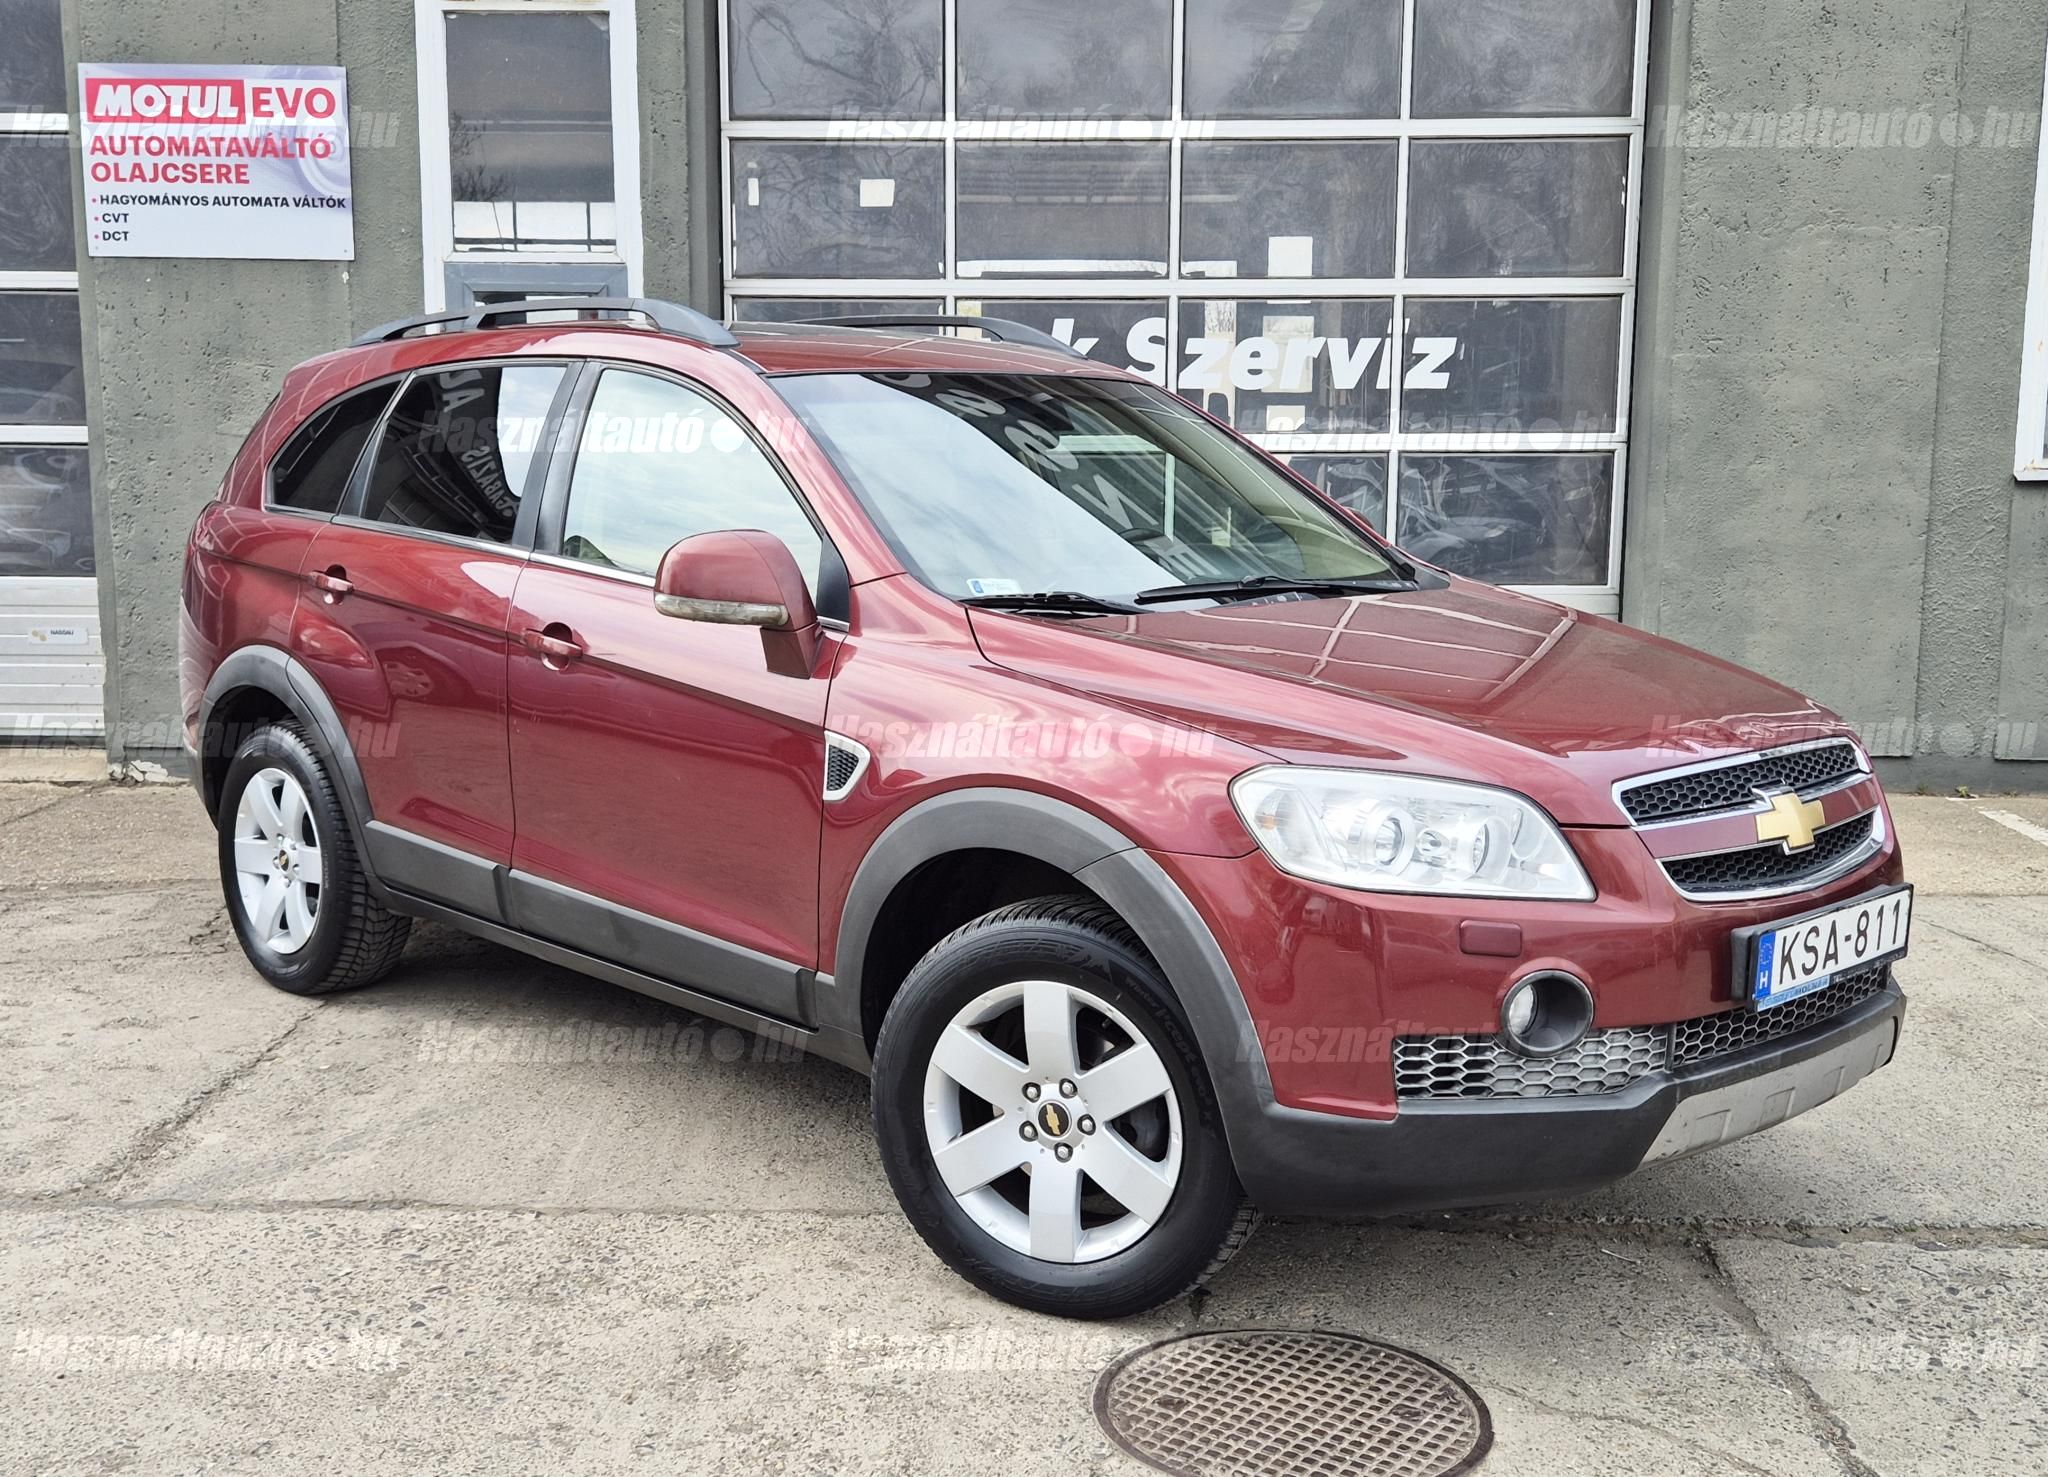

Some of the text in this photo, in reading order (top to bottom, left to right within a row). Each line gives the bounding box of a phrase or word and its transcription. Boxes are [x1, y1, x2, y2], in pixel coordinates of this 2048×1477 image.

[93, 84, 336, 119] MOTUL EVO
[89, 132, 332, 159] AUTOMATAVÁLTÓ
[91, 162, 251, 185] OLAJCSERE
[100, 193, 346, 209] HAGYOMÁNYOS AUTOMATA VÁLTÓK
[102, 213, 129, 223] CVT
[102, 231, 129, 241] DCT
[1124, 316, 1458, 390] Szerviz
[1759, 970, 1769, 989] H
[1779, 898, 1901, 986] KSA-811
